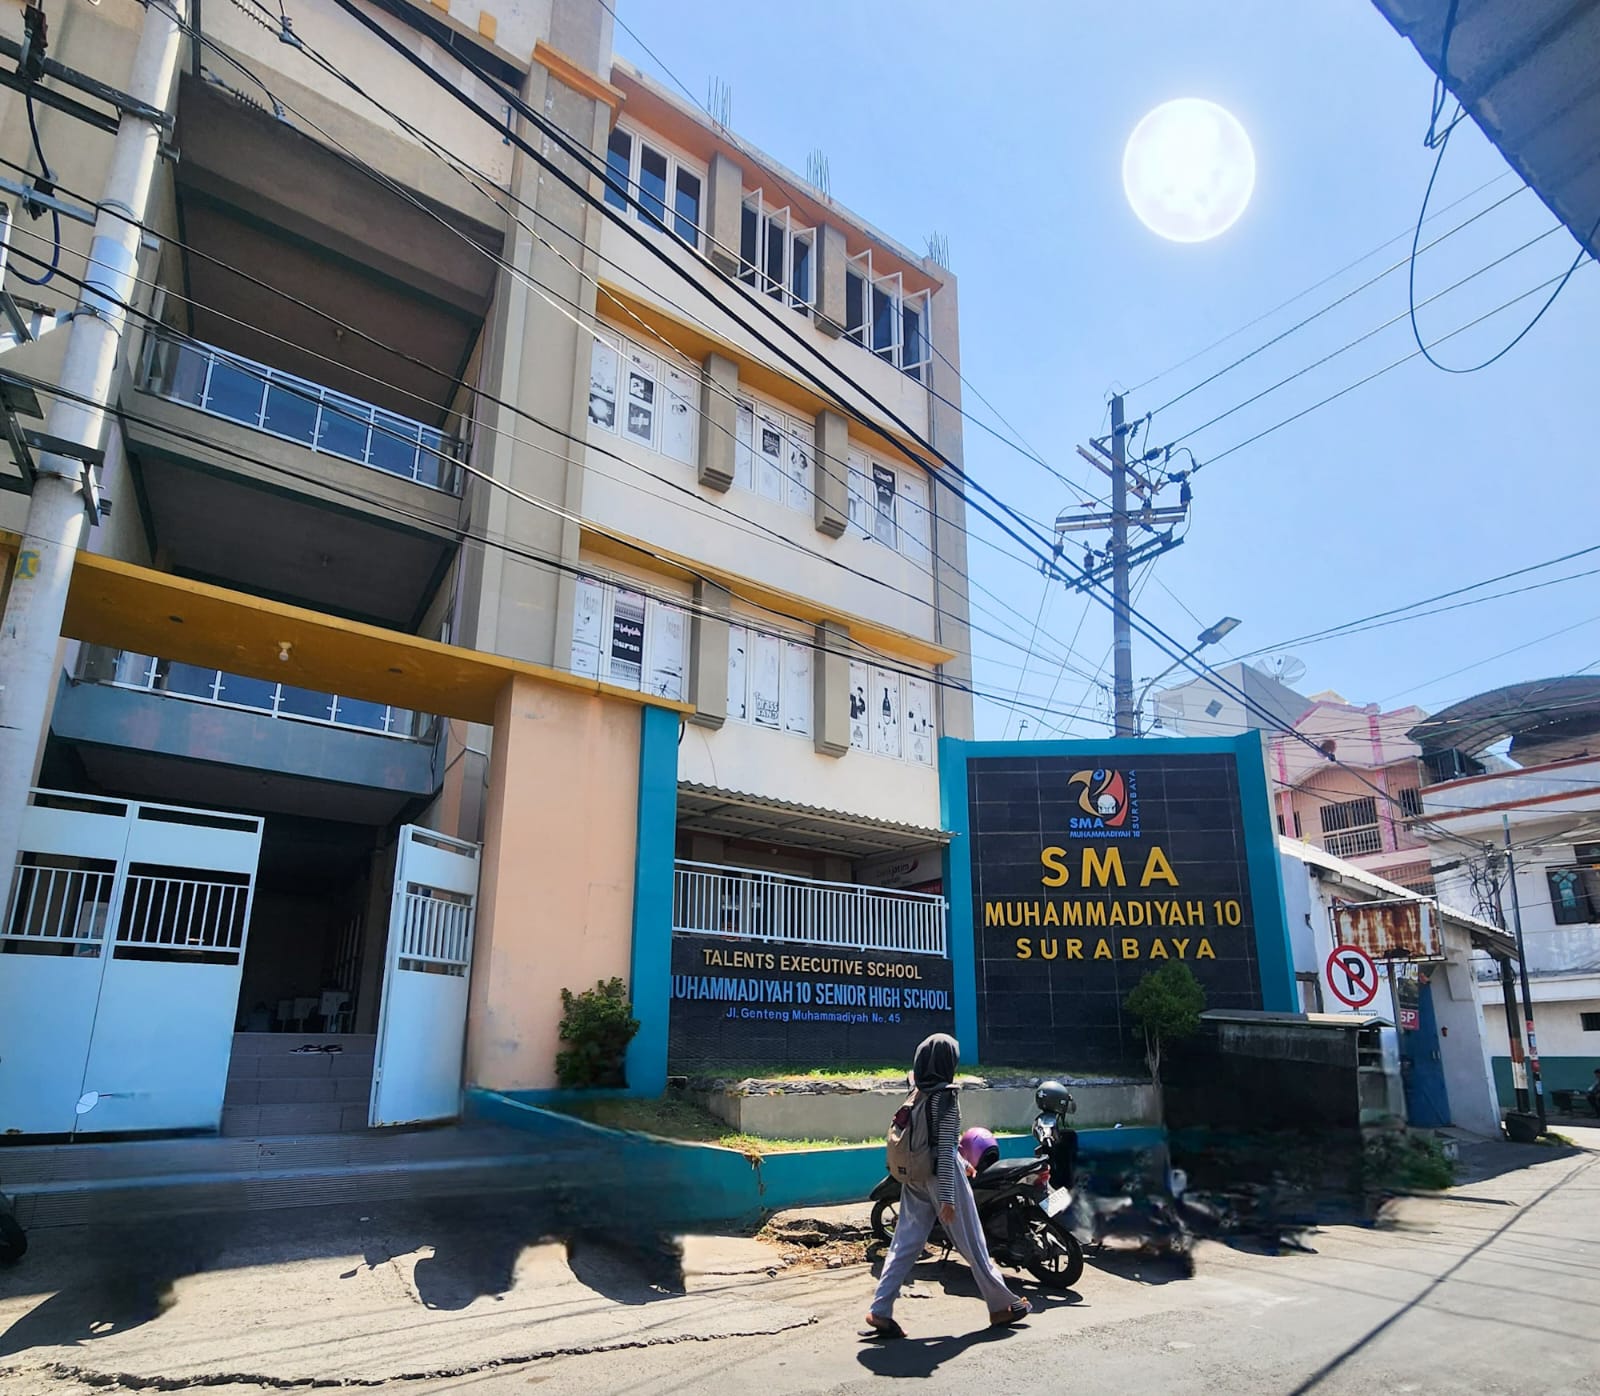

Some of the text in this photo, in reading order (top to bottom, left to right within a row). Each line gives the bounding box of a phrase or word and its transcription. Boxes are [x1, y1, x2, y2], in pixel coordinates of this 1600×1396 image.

[1128, 769, 1140, 829] SURABAYA
[1069, 817, 1104, 829] SMA
[1069, 830, 1141, 839] MUHAMMADIYAH 10
[1040, 846, 1180, 888] SMA
[984, 900, 1242, 927] MUHAMMADIYAH 10
[1015, 937, 1217, 960] SURABAYA
[703, 949, 923, 980] TALENTS EXECUTIVE SCHOOL
[795, 981, 811, 1003] 10
[815, 983, 867, 1006] SENIOR
[869, 986, 901, 1008] HIGH
[903, 988, 952, 1011] SCHOOL
[726, 1007, 901, 1025] Jl. Genteng Muhammadiyah No. 45
